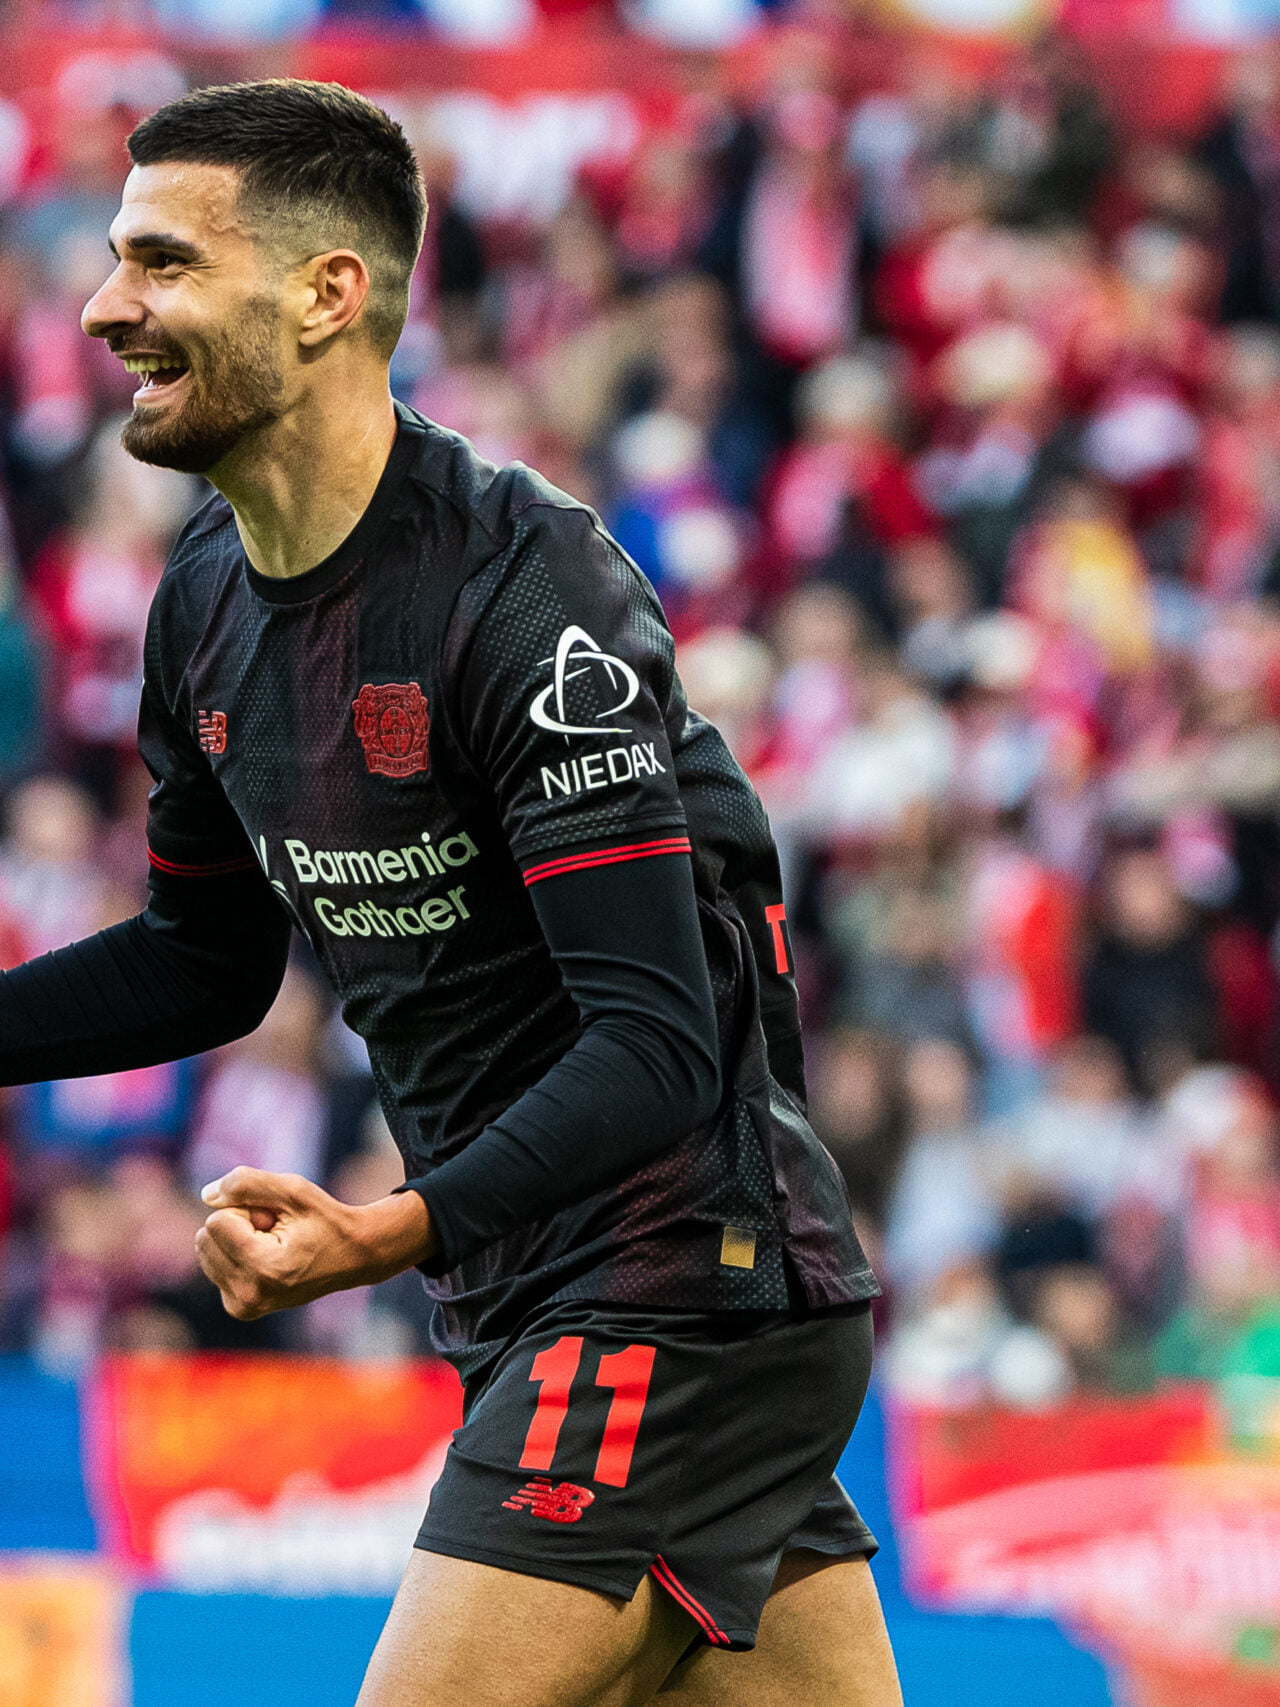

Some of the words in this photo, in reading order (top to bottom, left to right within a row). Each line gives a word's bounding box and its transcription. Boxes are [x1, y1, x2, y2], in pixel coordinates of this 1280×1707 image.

[540, 742, 667, 800] NIEDAX
[284, 831, 480, 885] Barmenia
[314, 885, 471, 937] Gothaer
[519, 1336, 657, 1489] 11
